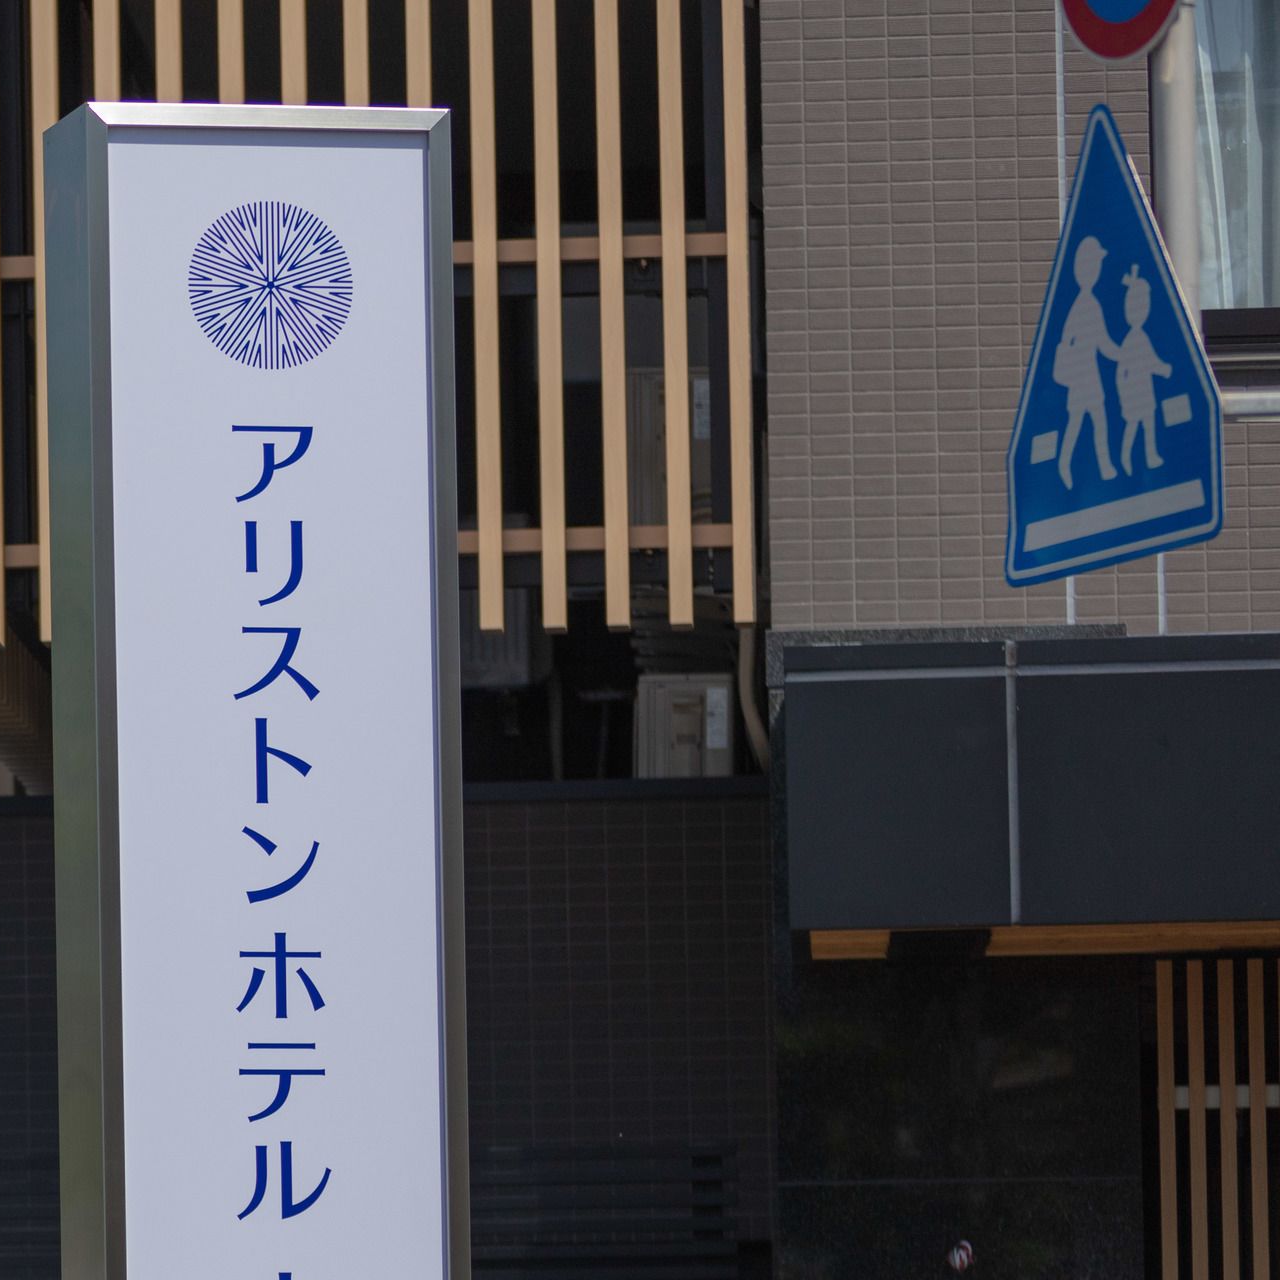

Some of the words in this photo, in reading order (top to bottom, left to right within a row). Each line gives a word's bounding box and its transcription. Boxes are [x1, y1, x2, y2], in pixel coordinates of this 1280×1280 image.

[231, 424, 332, 1221] アリストンホテル
